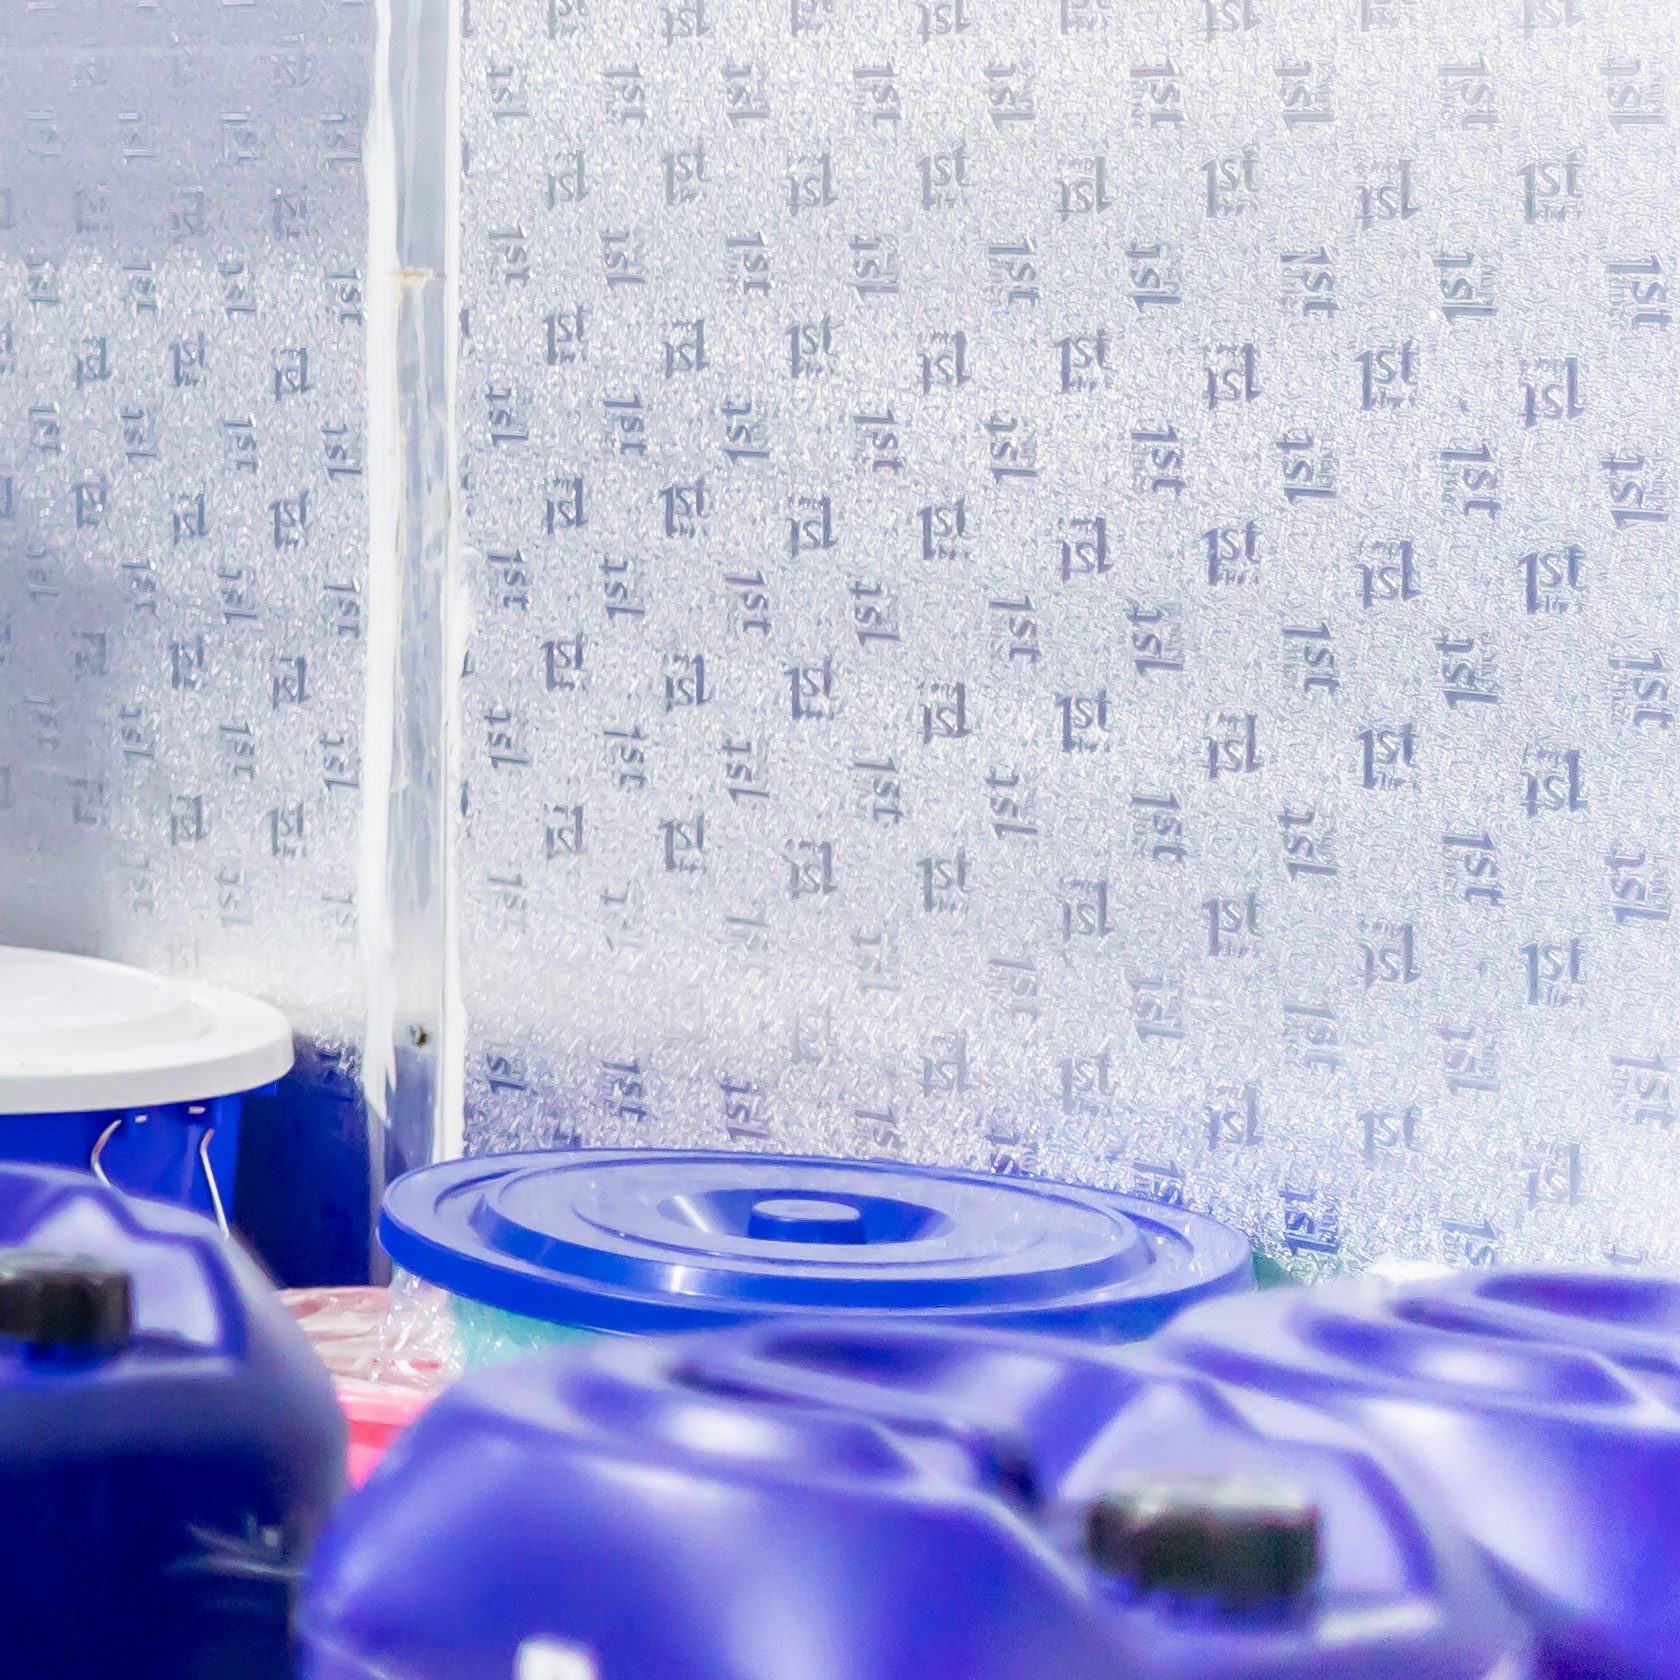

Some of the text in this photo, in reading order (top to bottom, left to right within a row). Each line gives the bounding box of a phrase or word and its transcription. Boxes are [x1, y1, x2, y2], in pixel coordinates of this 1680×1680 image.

[787, 151, 835, 215] 1st
[1057, 154, 1109, 220] 1st
[1203, 146, 1256, 216] 1st
[1358, 158, 1419, 229] 1st
[1518, 151, 1580, 222] 1st
[724, 233, 769, 292] 1st
[850, 236, 898, 295] 1st
[986, 240, 1038, 304] 1st
[1125, 241, 1180, 308] 1st
[1280, 248, 1337, 315] 1st
[1435, 251, 1496, 320] 1st
[1608, 257, 1670, 327] 1st
[544, 306, 587, 364] 1st
[662, 319, 707, 377] 1st
[787, 316, 832, 376] 1st
[919, 331, 968, 392] 1st
[1054, 328, 1107, 392] 1st
[1202, 342, 1259, 409] 1st
[1357, 341, 1415, 409] 1st
[1521, 356, 1582, 426] 1st
[485, 387, 529, 446] 1st
[604, 394, 645, 455] 1st
[722, 400, 768, 462] 1st
[853, 409, 903, 472] 1st
[984, 415, 1037, 483] 1st
[1132, 426, 1185, 493] 1st
[1275, 435, 1336, 502] 1st
[1436, 444, 1500, 517] 1st
[1601, 454, 1665, 526] 1st
[660, 477, 705, 535] 1st
[788, 496, 835, 559] 1st
[918, 497, 966, 559] 1st
[486, 551, 529, 610] 1st
[1059, 516, 1109, 581] 1st
[1202, 520, 1257, 584] 1st
[1357, 539, 1417, 608] 1st
[1517, 544, 1583, 613] 1st
[601, 558, 643, 618] 1st
[726, 572, 770, 633] 1st
[850, 580, 898, 644] 1st
[990, 596, 1039, 662] 1st
[1126, 602, 1182, 674] 1st
[1282, 623, 1339, 693] 1st
[662, 648, 709, 712] 1st
[786, 656, 834, 720] 1st
[1436, 633, 1497, 707] 1st
[1609, 653, 1678, 726] 1st
[919, 682, 970, 743] 1st
[1056, 689, 1109, 752] 1st
[722, 738, 768, 800] 1st
[1205, 713, 1259, 778] 1st
[1357, 722, 1415, 788] 1st
[853, 758, 903, 822] 1st
[986, 770, 1037, 836] 1st
[1523, 748, 1585, 816] 1st
[660, 813, 707, 873] 1st
[1131, 794, 1187, 861] 1st
[1279, 808, 1337, 877] 1st
[918, 852, 968, 911] 1st
[1441, 833, 1501, 905] 1st
[1607, 846, 1668, 924] 1st
[1203, 890, 1260, 954] 1st
[1360, 920, 1419, 985] 1st
[1522, 938, 1583, 1004] 1st
